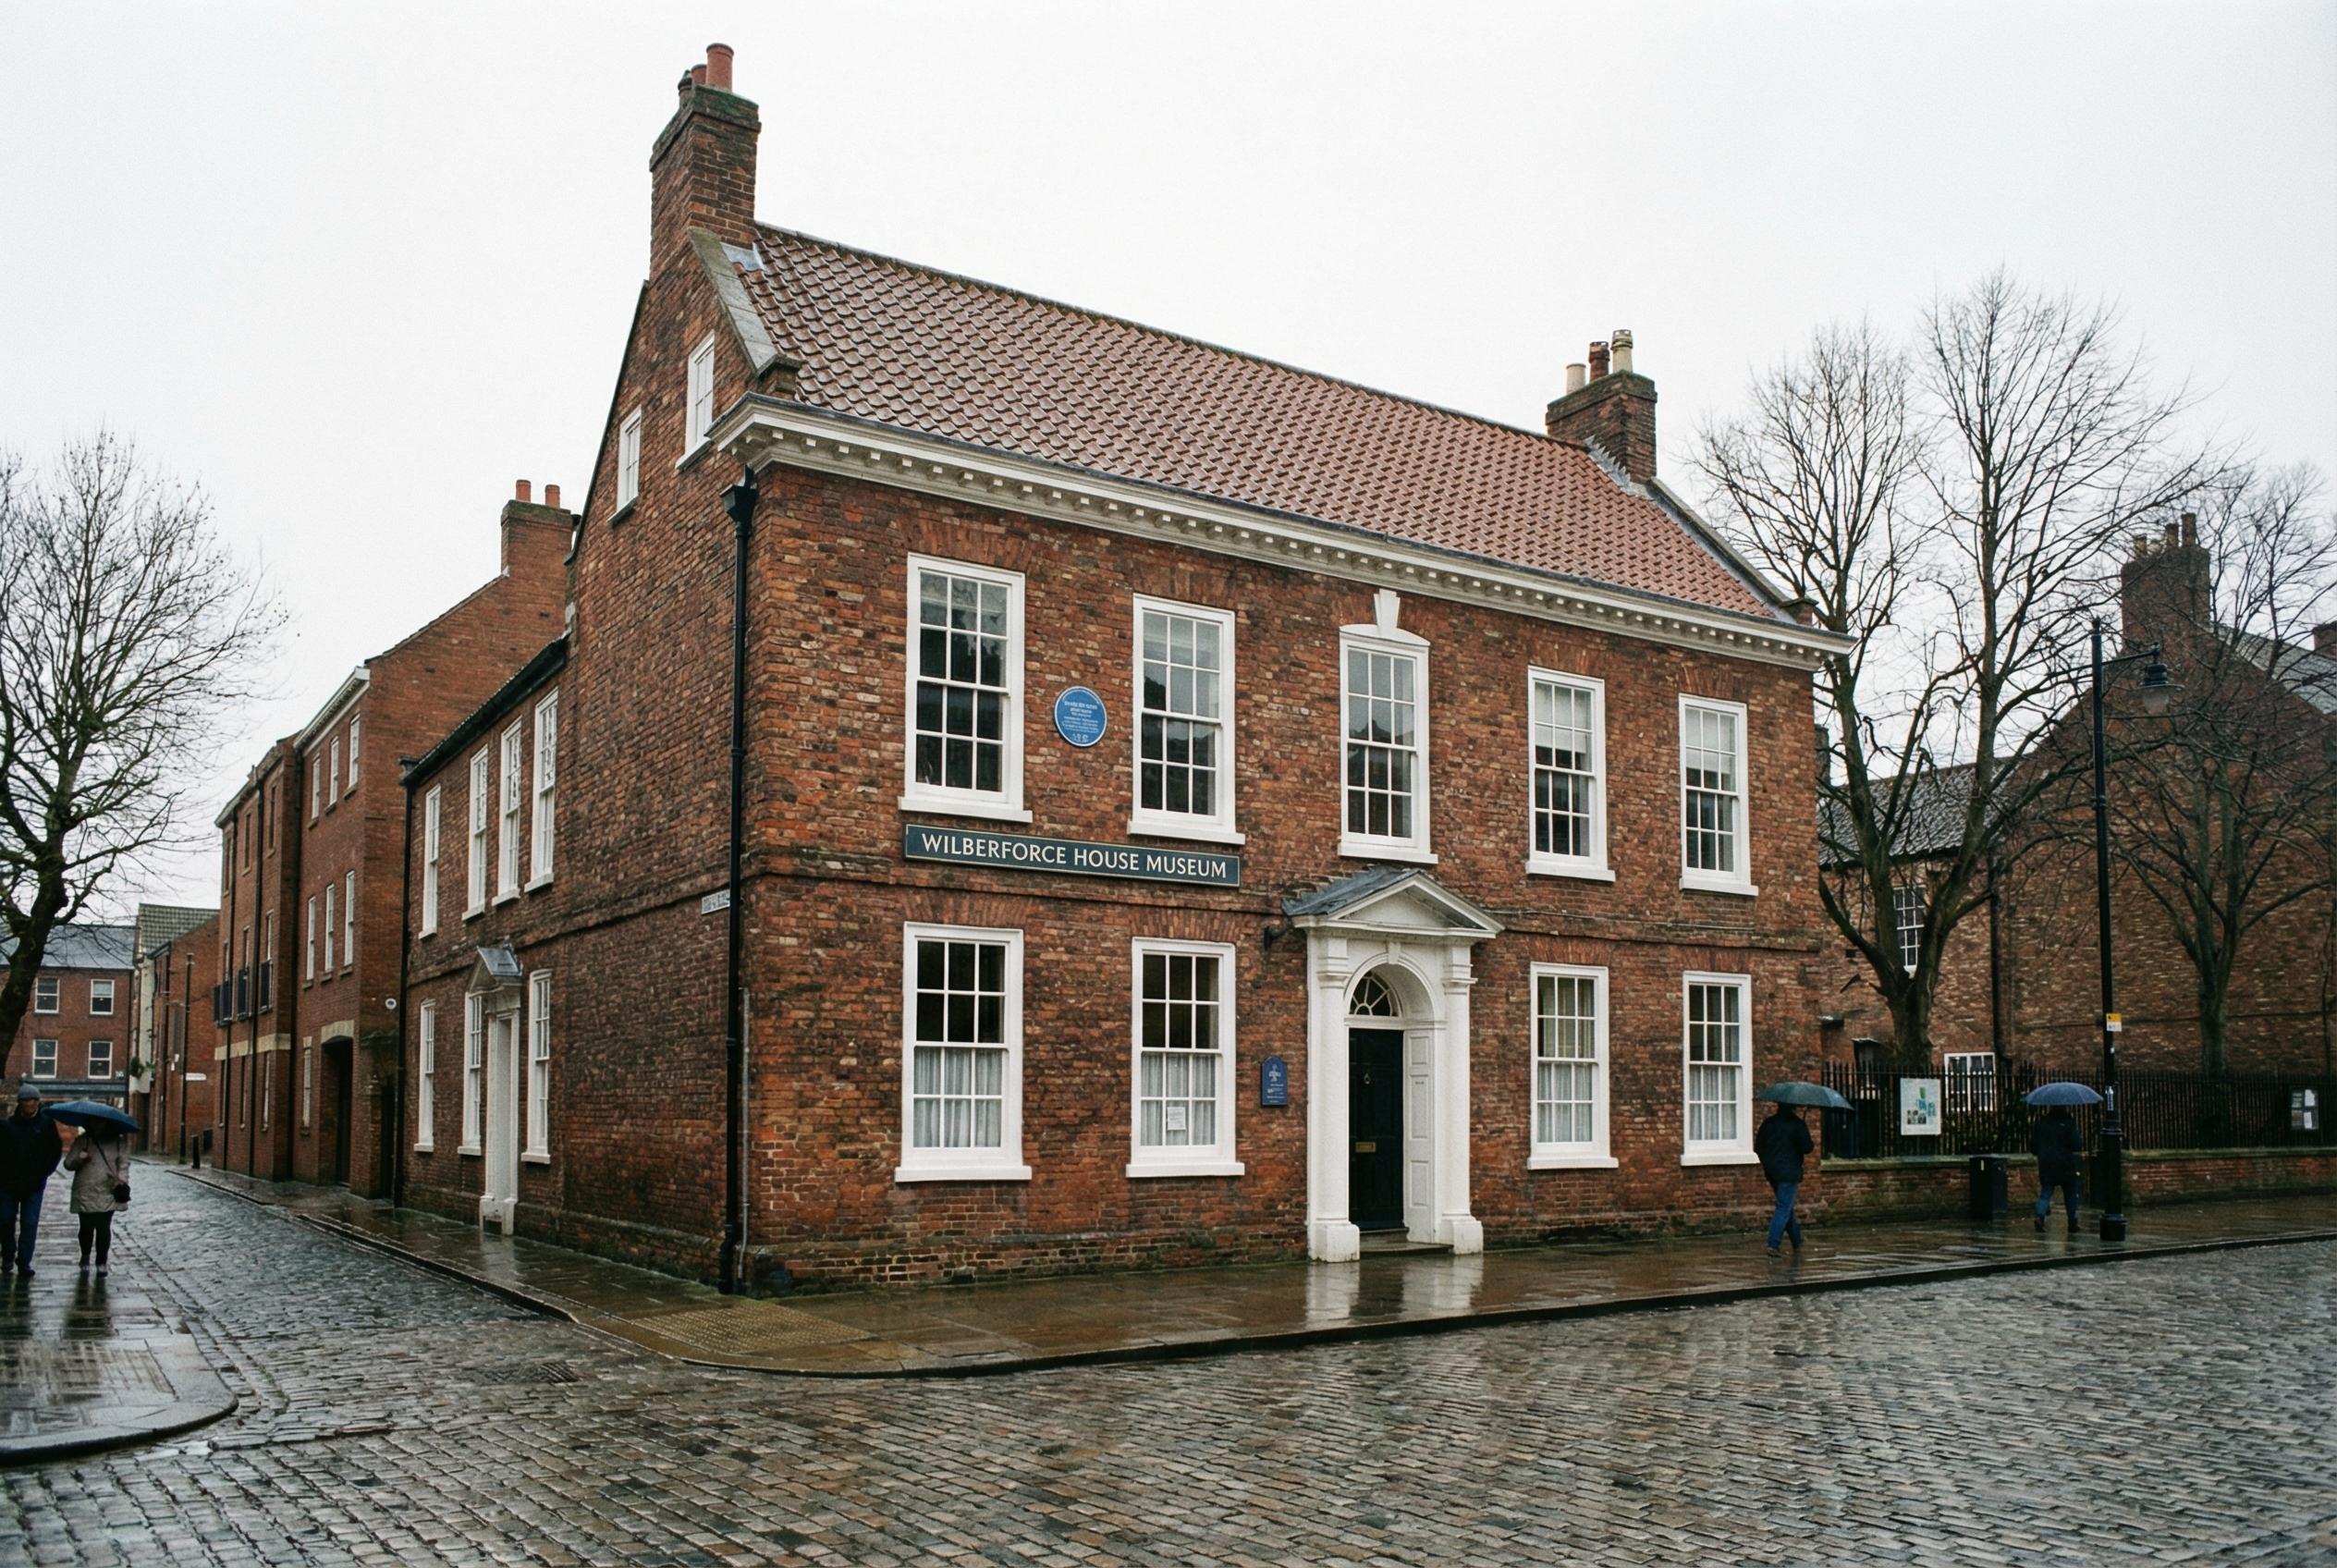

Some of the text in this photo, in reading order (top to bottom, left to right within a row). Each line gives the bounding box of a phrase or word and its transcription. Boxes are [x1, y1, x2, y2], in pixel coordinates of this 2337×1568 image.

[922, 834, 1226, 877] WILBERFORCE HOUSE MUSEUM
